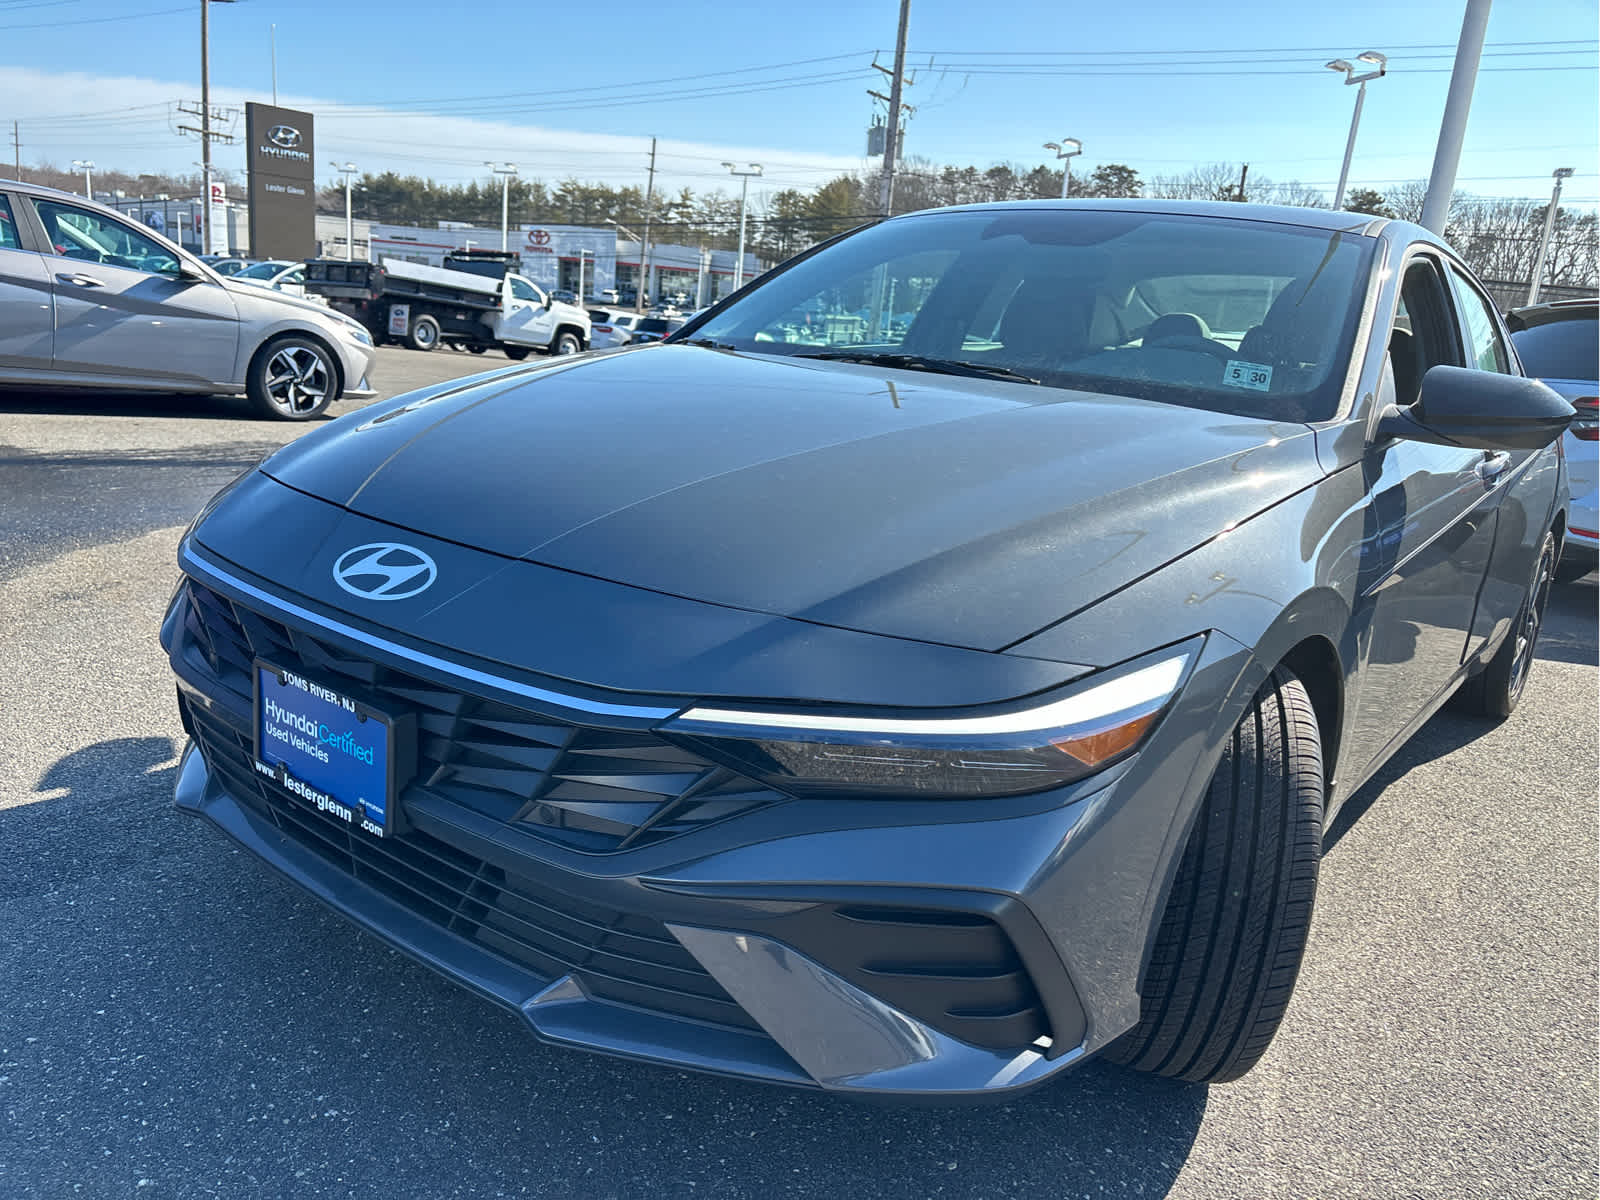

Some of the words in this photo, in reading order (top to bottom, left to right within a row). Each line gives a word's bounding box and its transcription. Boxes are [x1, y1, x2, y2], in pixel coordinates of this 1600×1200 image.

[260, 145, 310, 163] HYUNDAI
[1232, 369, 1241, 379] 5
[1250, 371, 1267, 384] 30
[281, 670, 308, 692] TOMS
[310, 682, 341, 708] RIVER,
[342, 697, 356, 713] NJ
[265, 697, 318, 739] Hyundai
[319, 723, 374, 766] Certified
[265, 721, 289, 743] Used
[289, 731, 329, 764] Vehicles
[283, 773, 353, 823] lesterglenn
